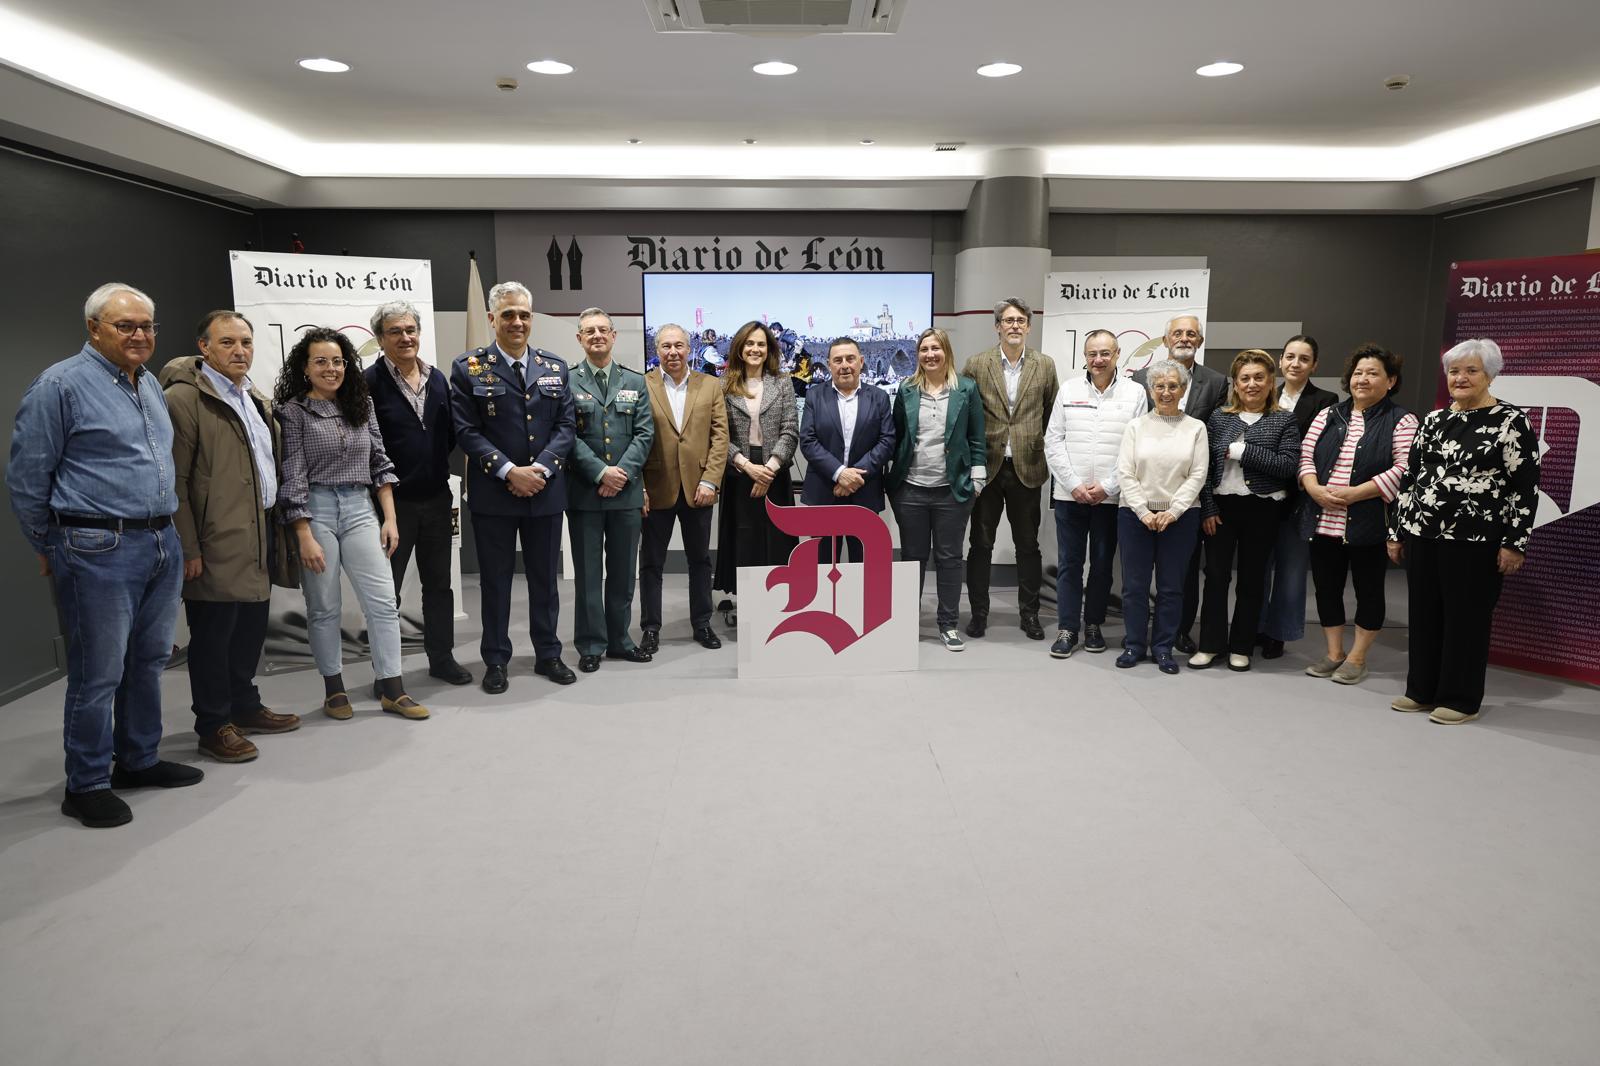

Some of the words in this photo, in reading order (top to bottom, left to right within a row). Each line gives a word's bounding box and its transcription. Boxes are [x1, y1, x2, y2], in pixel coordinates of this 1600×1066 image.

[627, 235, 742, 271] Diario
[755, 240, 788, 271] de
[802, 237, 885, 271] León
[254, 266, 328, 288] Diario
[335, 271, 356, 290] de
[364, 272, 413, 292] León
[1060, 283, 1117, 300] Diario
[1123, 284, 1140, 300] de
[1147, 282, 1190, 299] León
[1460, 274, 1541, 299] Diario
[1550, 274, 1578, 295] de
